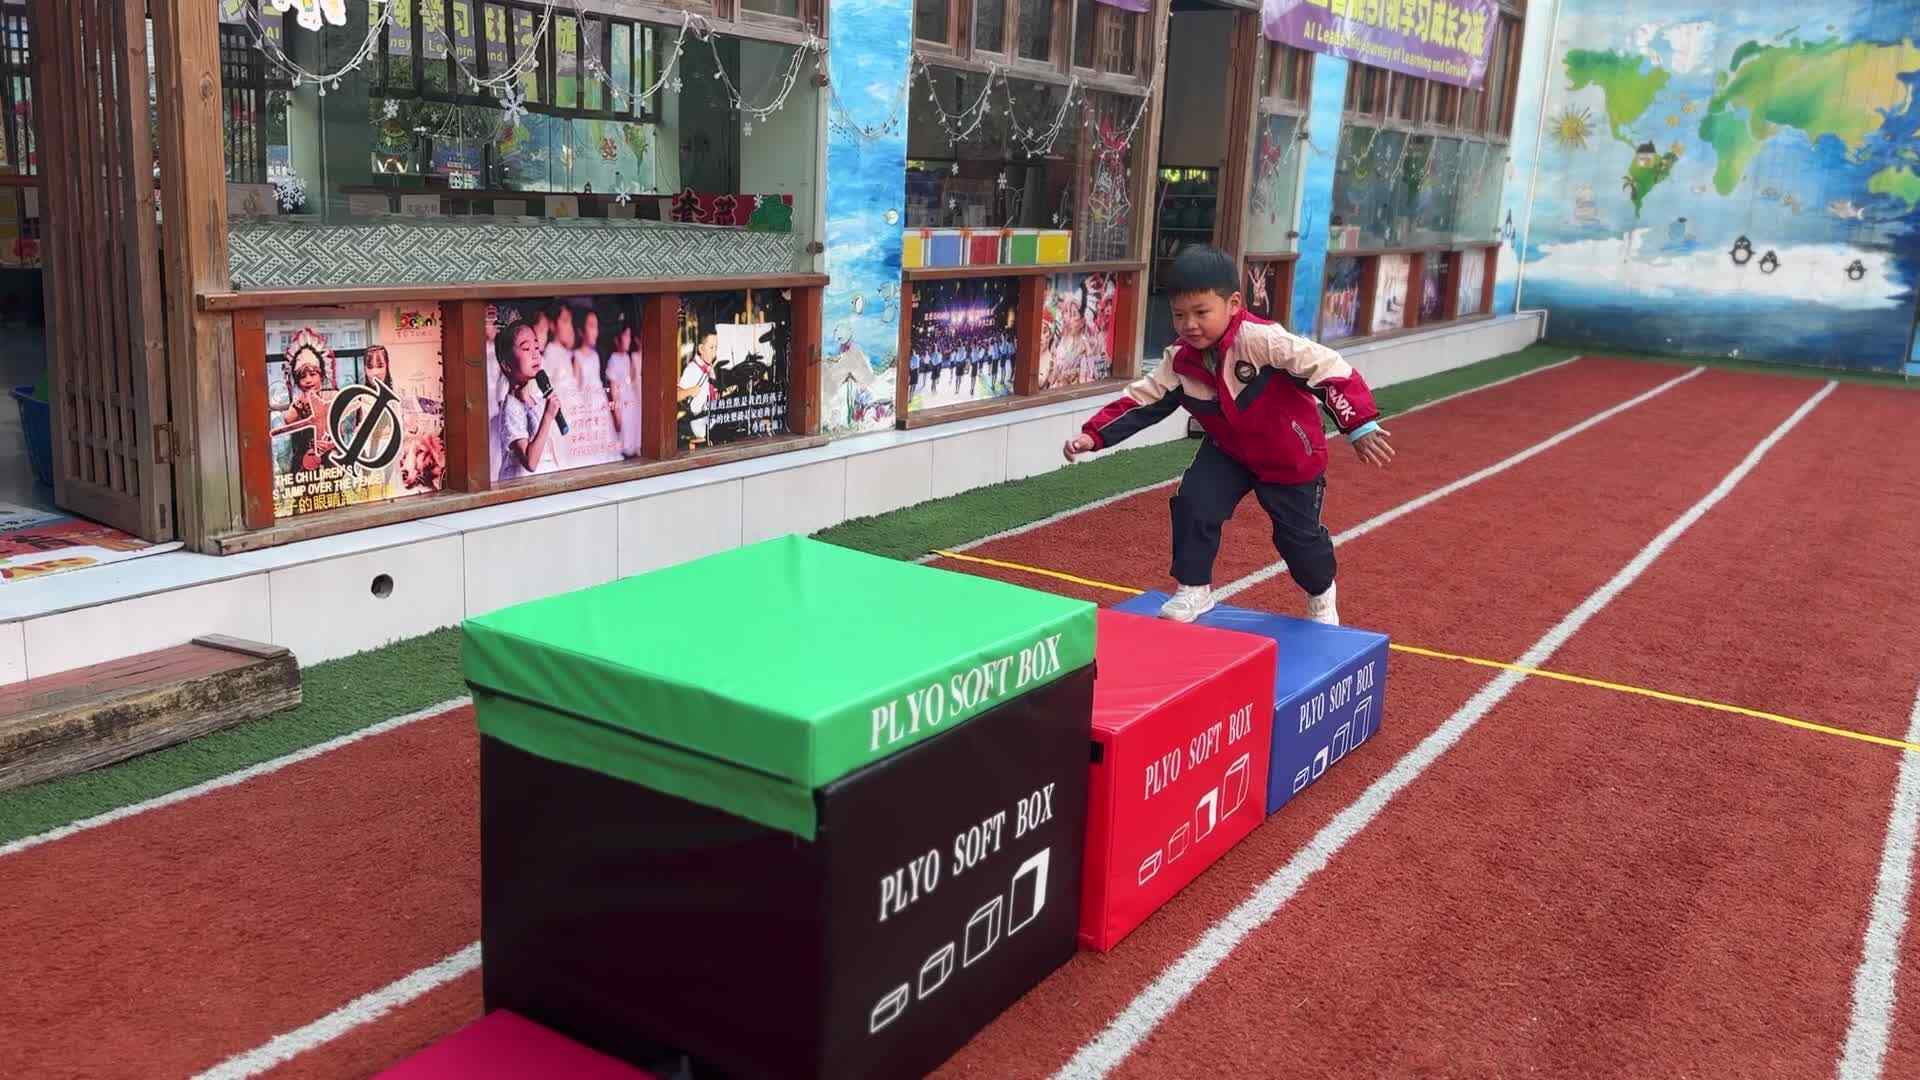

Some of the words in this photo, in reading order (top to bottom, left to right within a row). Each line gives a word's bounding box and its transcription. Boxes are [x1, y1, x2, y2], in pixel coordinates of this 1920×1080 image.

[1303, 20, 1316, 40] AI
[1401, 48, 1431, 72] Learning
[1432, 57, 1444, 73] and
[274, 473, 294, 486] THE
[308, 481, 332, 495] OVER
[870, 683, 944, 752] PLYO
[950, 655, 1014, 717] SOFT
[1016, 633, 1062, 689] BOX
[1298, 691, 1325, 734] PLYO
[1329, 675, 1353, 713] SOFT
[1356, 660, 1375, 696] BOX
[1144, 752, 1181, 800] PLYO
[1188, 721, 1223, 770] SOFT
[1228, 702, 1254, 745] BOX
[878, 848, 941, 922] PLYO
[952, 811, 1006, 877] SOFT
[1015, 782, 1056, 838] BOX
